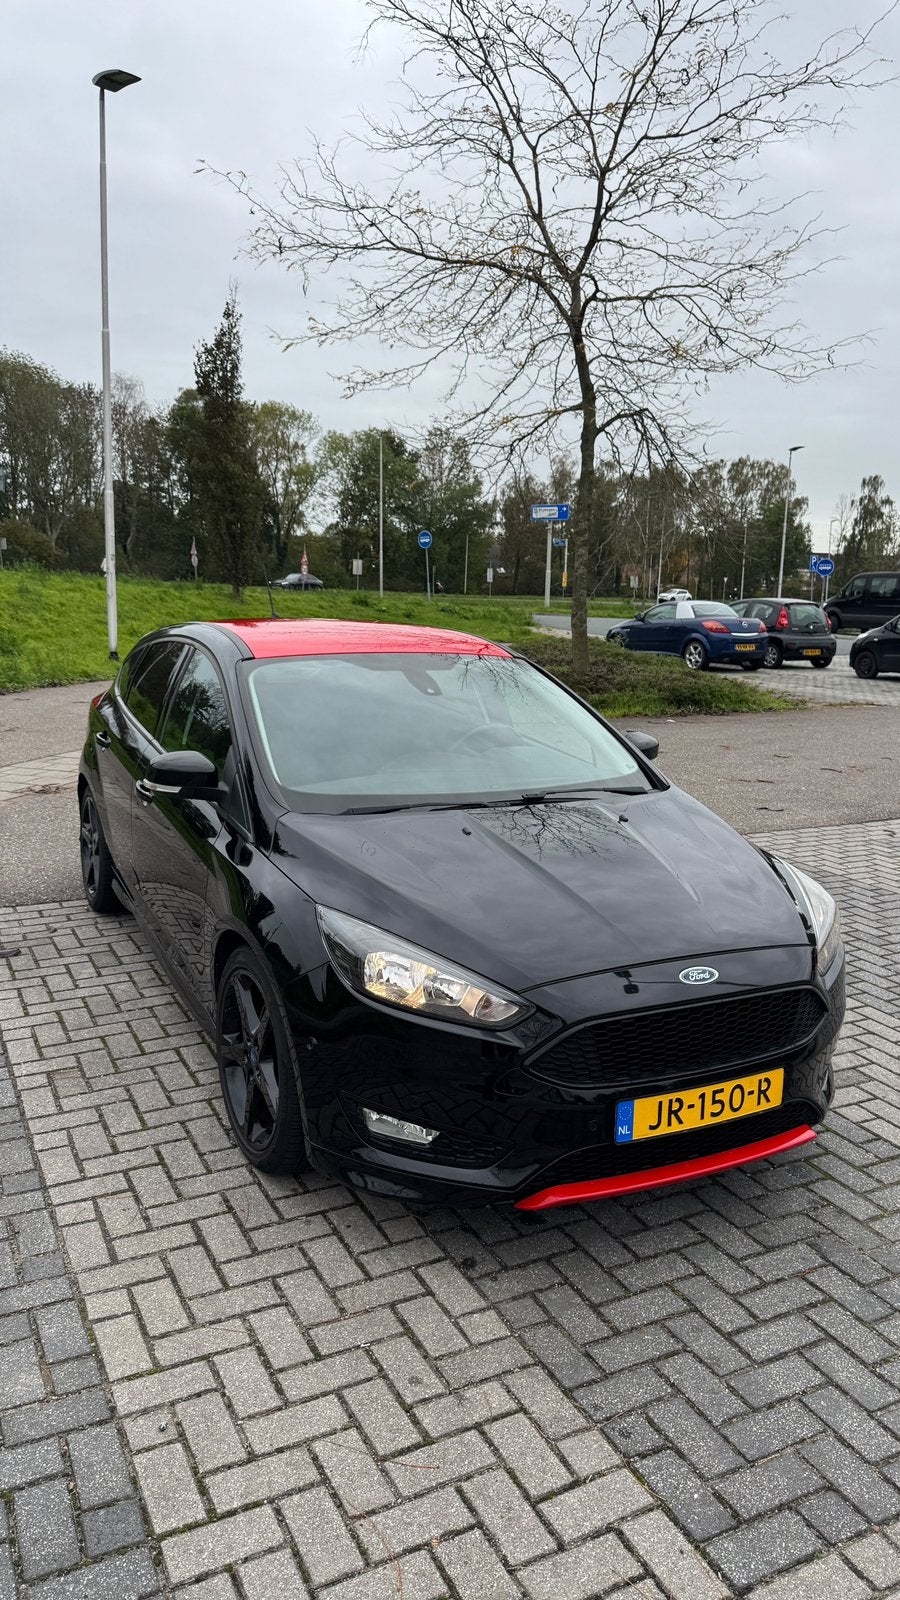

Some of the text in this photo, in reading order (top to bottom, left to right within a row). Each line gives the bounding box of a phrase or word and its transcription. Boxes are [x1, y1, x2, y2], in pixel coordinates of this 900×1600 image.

[689, 970, 710, 981] Ford
[648, 1076, 772, 1131] JR-150-R
[618, 1125, 631, 1136] NL
